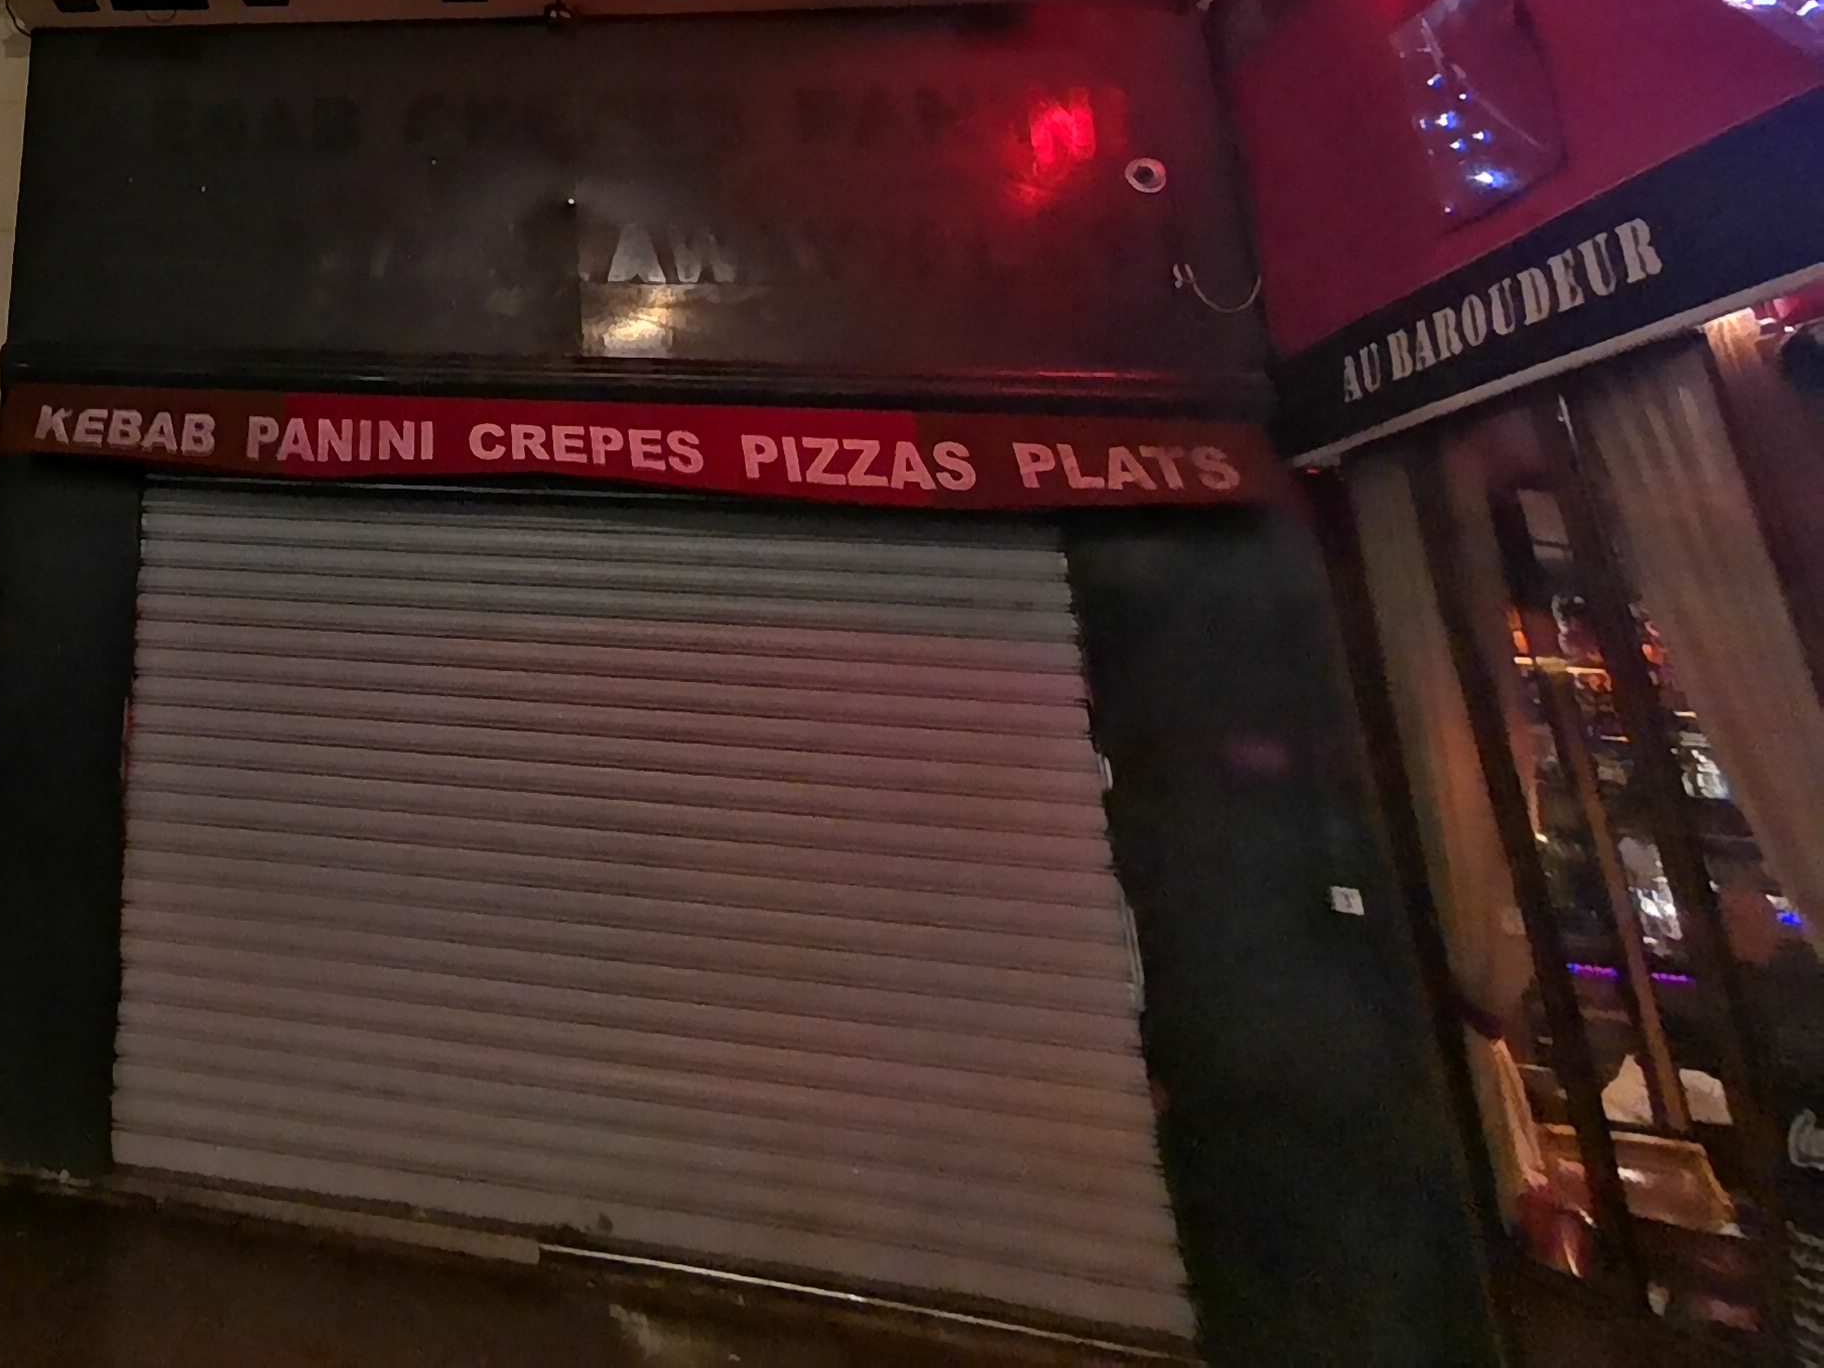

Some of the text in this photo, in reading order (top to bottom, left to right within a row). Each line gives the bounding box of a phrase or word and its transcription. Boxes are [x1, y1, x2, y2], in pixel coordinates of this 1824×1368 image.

[1343, 218, 1663, 402] AU BAROUDEUR
[36, 407, 1240, 493] KEBAB PANINI CREPES PIZZAS PLATS
